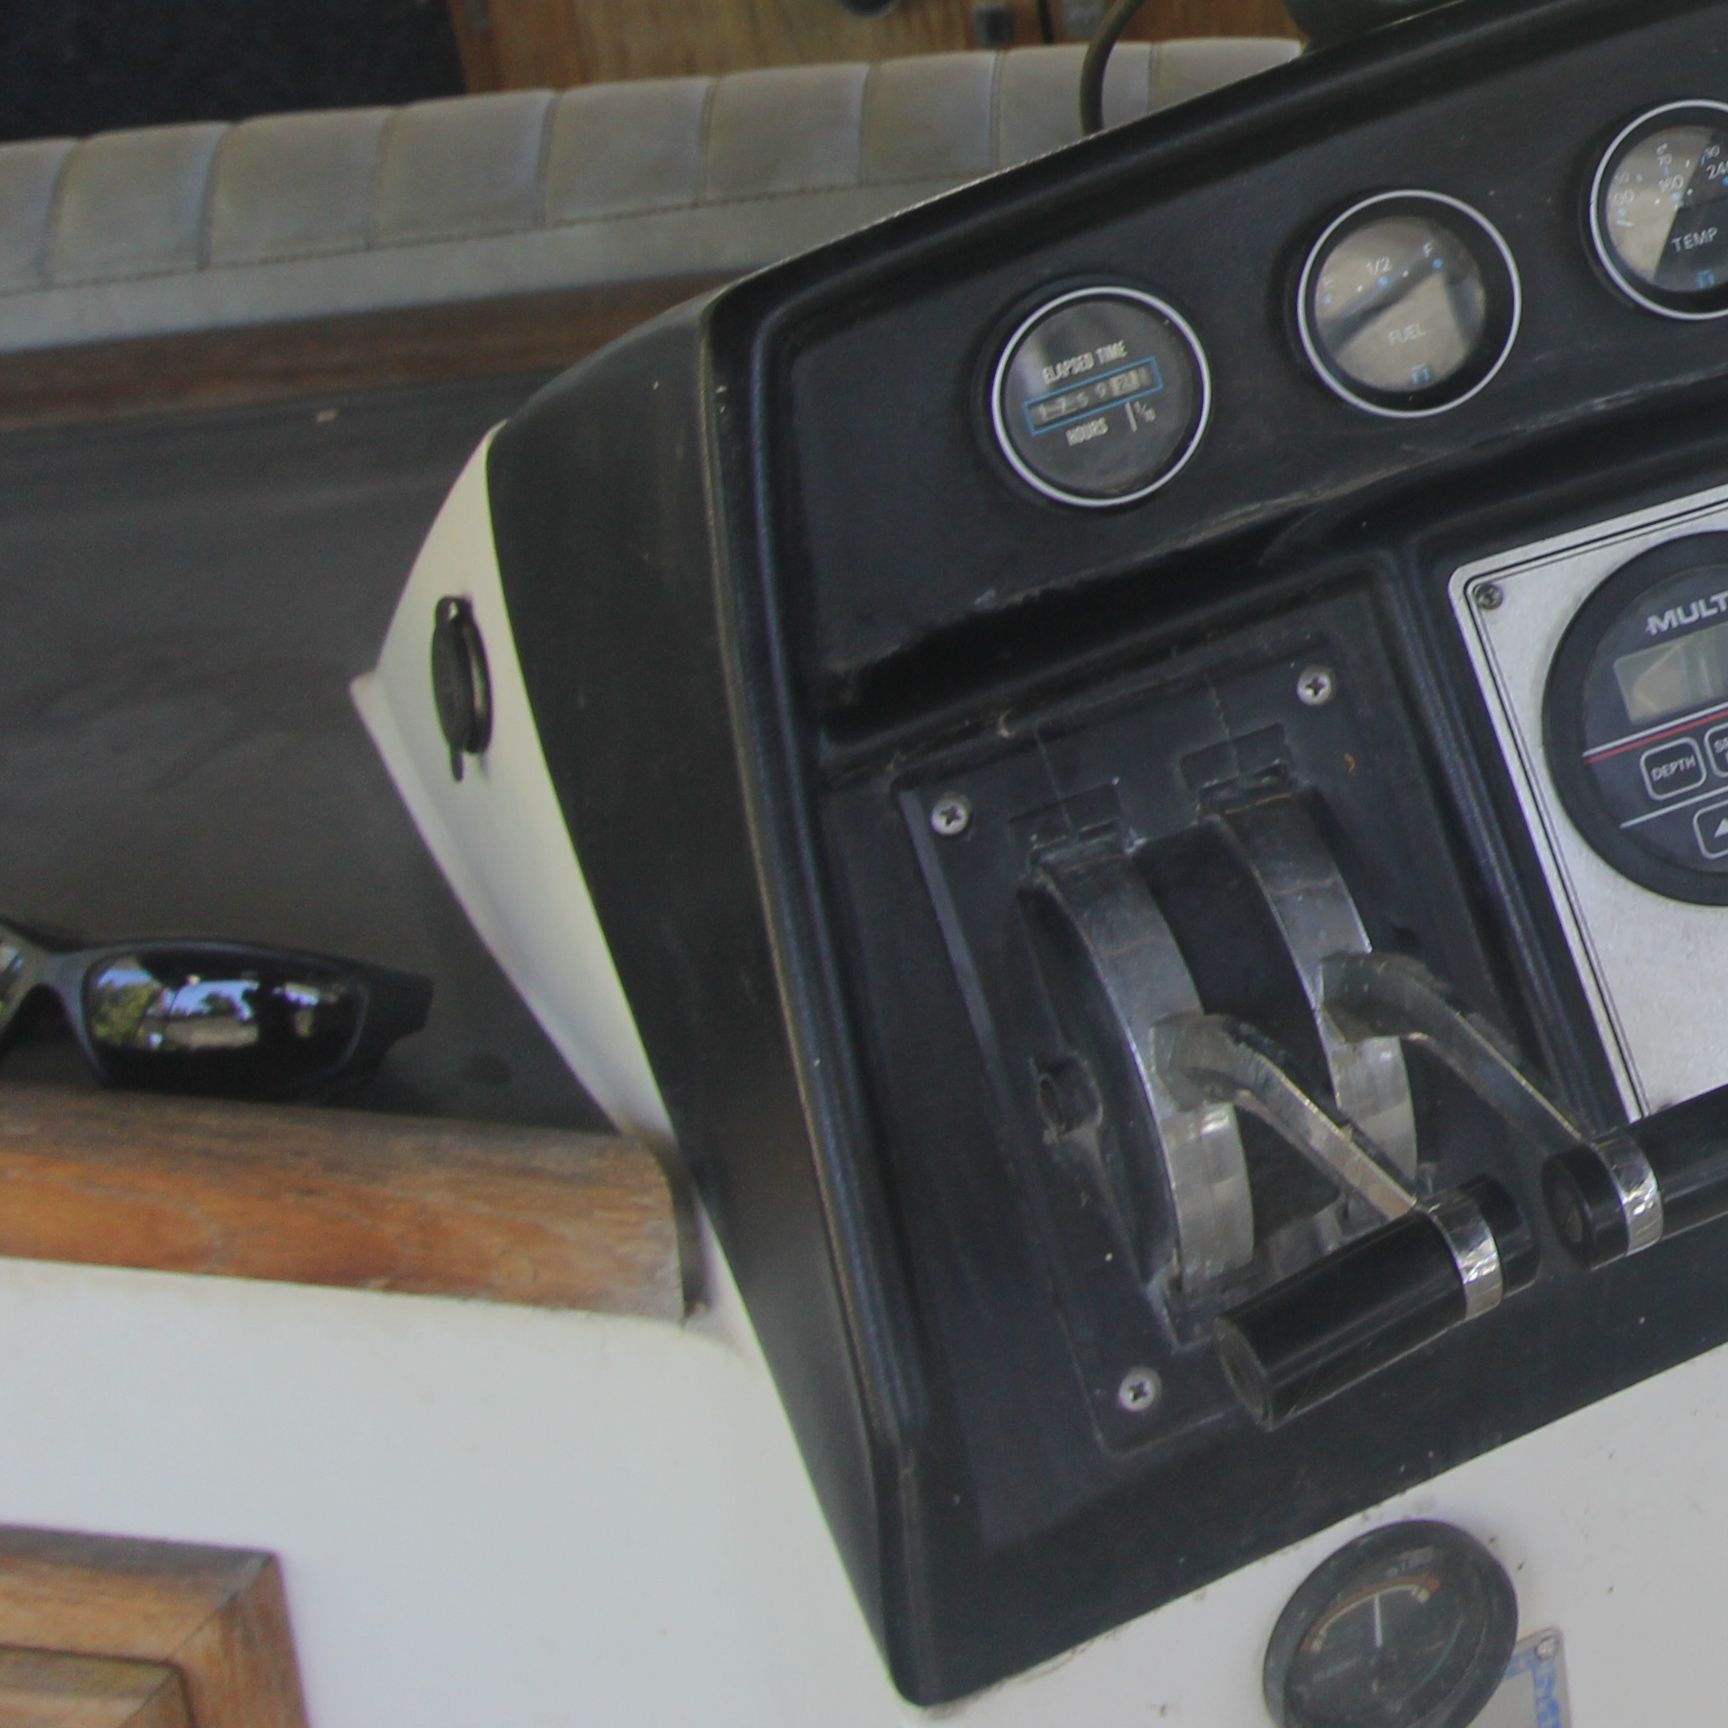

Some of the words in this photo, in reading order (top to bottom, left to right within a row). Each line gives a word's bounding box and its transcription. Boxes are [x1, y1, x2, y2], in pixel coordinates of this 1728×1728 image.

[1672, 227, 1717, 252] TEMP
[1366, 257, 1391, 275] 1/2
[1388, 323, 1426, 346] FUEL
[1042, 352, 1095, 385] ELAPSED
[1095, 340, 1128, 365] TIME
[1065, 417, 1108, 446] HOURS
[1650, 755, 1696, 782] DEPTH
